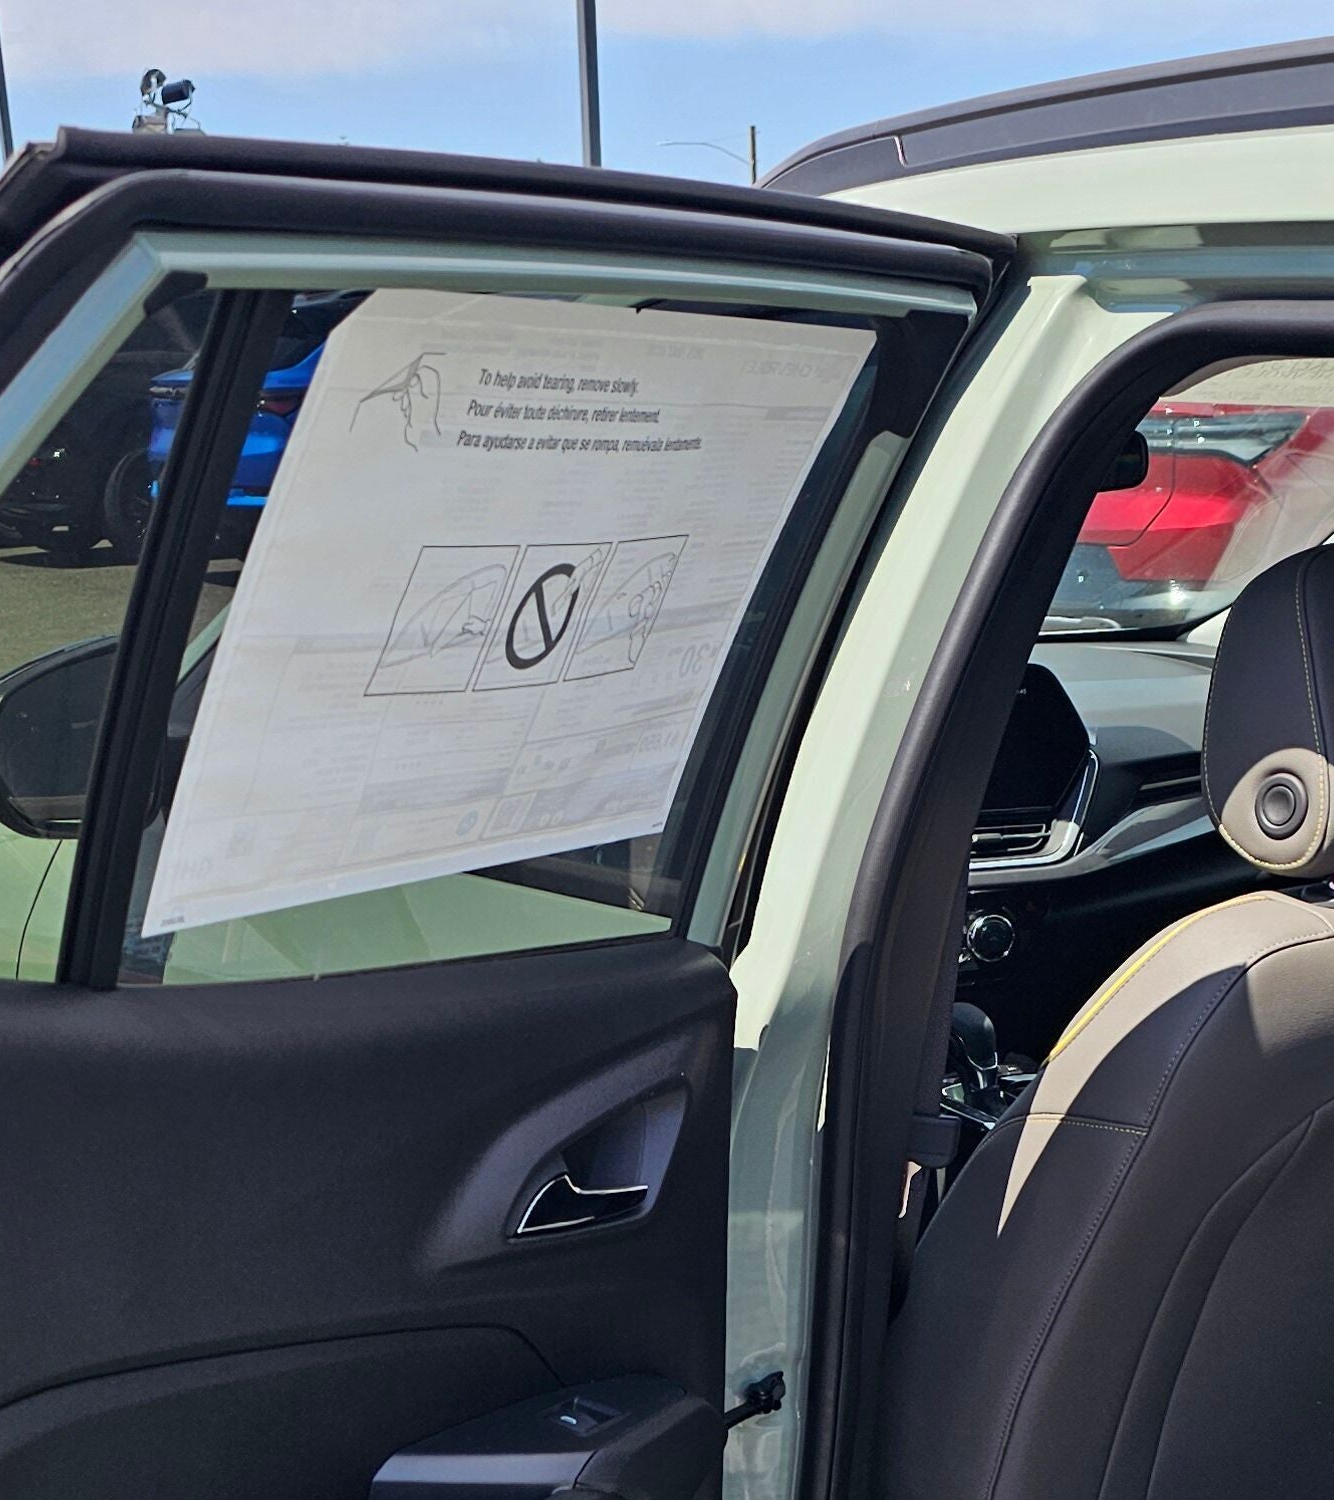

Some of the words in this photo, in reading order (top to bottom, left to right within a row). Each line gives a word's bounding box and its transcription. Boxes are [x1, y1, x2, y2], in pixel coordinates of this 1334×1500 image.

[479, 368, 492, 386] To
[493, 370, 516, 392] help
[516, 372, 543, 389] avoid
[542, 373, 576, 394] tearing,
[578, 378, 610, 392] remove
[467, 399, 493, 417] Pour
[494, 401, 522, 419] éviter
[523, 404, 546, 420] toute
[591, 407, 619, 422] retirer
[456, 429, 482, 448] Para
[482, 434, 527, 452] ayudarse
[527, 438, 535, 450] a
[535, 435, 562, 450] evitar
[561, 438, 579, 453] que
[579, 438, 591, 451] se
[591, 439, 620, 454] rompa,
[621, 436, 664, 452] remuévala
